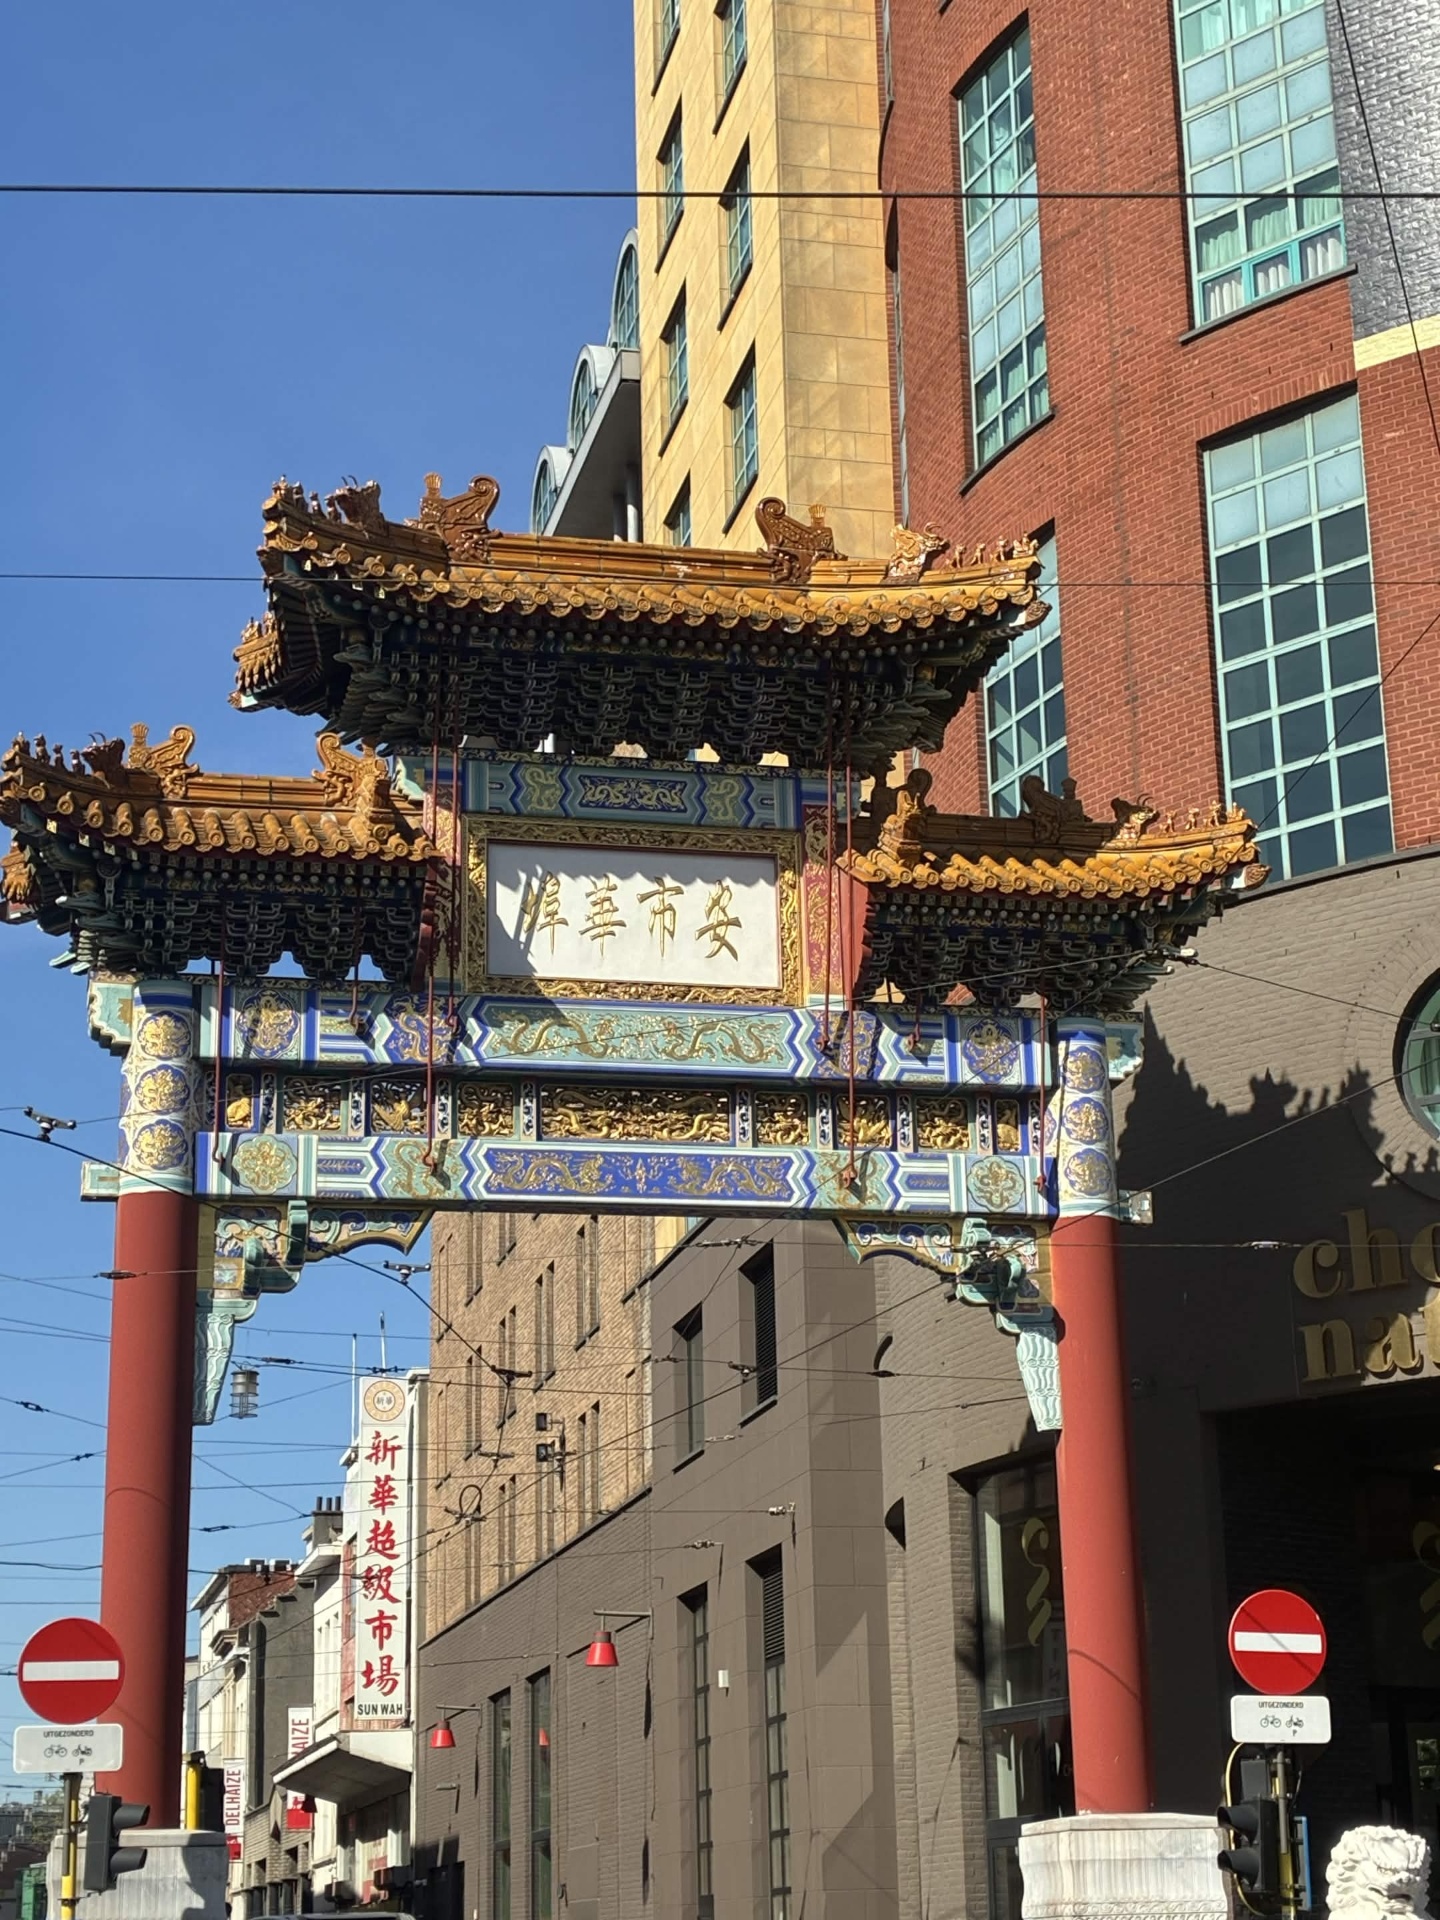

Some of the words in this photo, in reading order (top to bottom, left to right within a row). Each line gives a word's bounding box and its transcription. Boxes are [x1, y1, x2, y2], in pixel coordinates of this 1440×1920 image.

[361, 1429, 402, 1698] 新華超級市場
[357, 1703, 378, 1716] SUN
[380, 1703, 403, 1716] WAH
[1258, 1701, 1304, 1709] UITGEZONDERD
[43, 1729, 95, 1738] UITGEZONDERD
[225, 1769, 241, 1826] DELHAIZE
